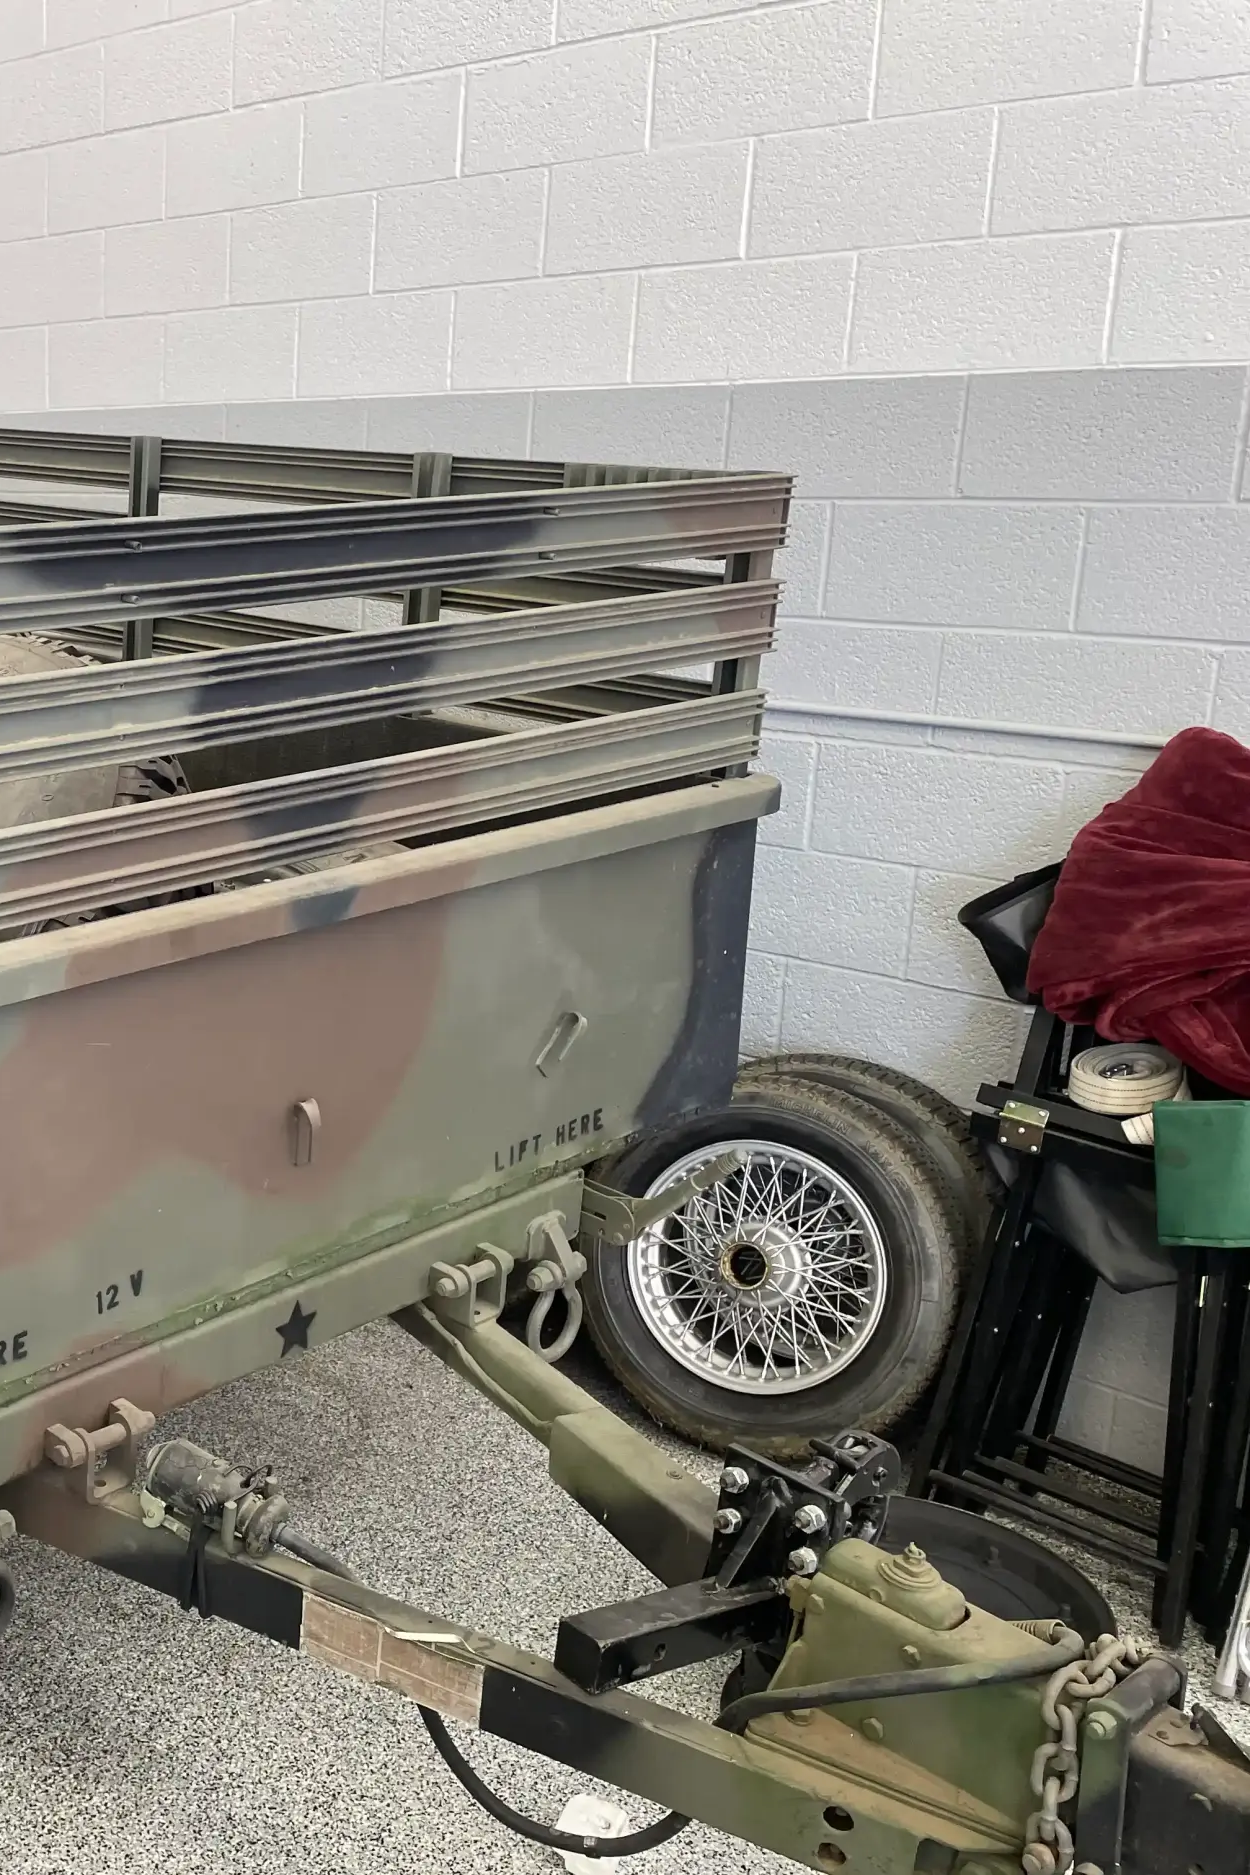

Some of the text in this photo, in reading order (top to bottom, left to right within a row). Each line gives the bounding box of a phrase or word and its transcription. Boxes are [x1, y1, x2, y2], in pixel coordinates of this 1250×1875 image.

[772, 1096, 851, 1135] MICHELIN
[494, 1107, 604, 1172] LIFT HERE
[95, 1269, 143, 1315] 12 V
